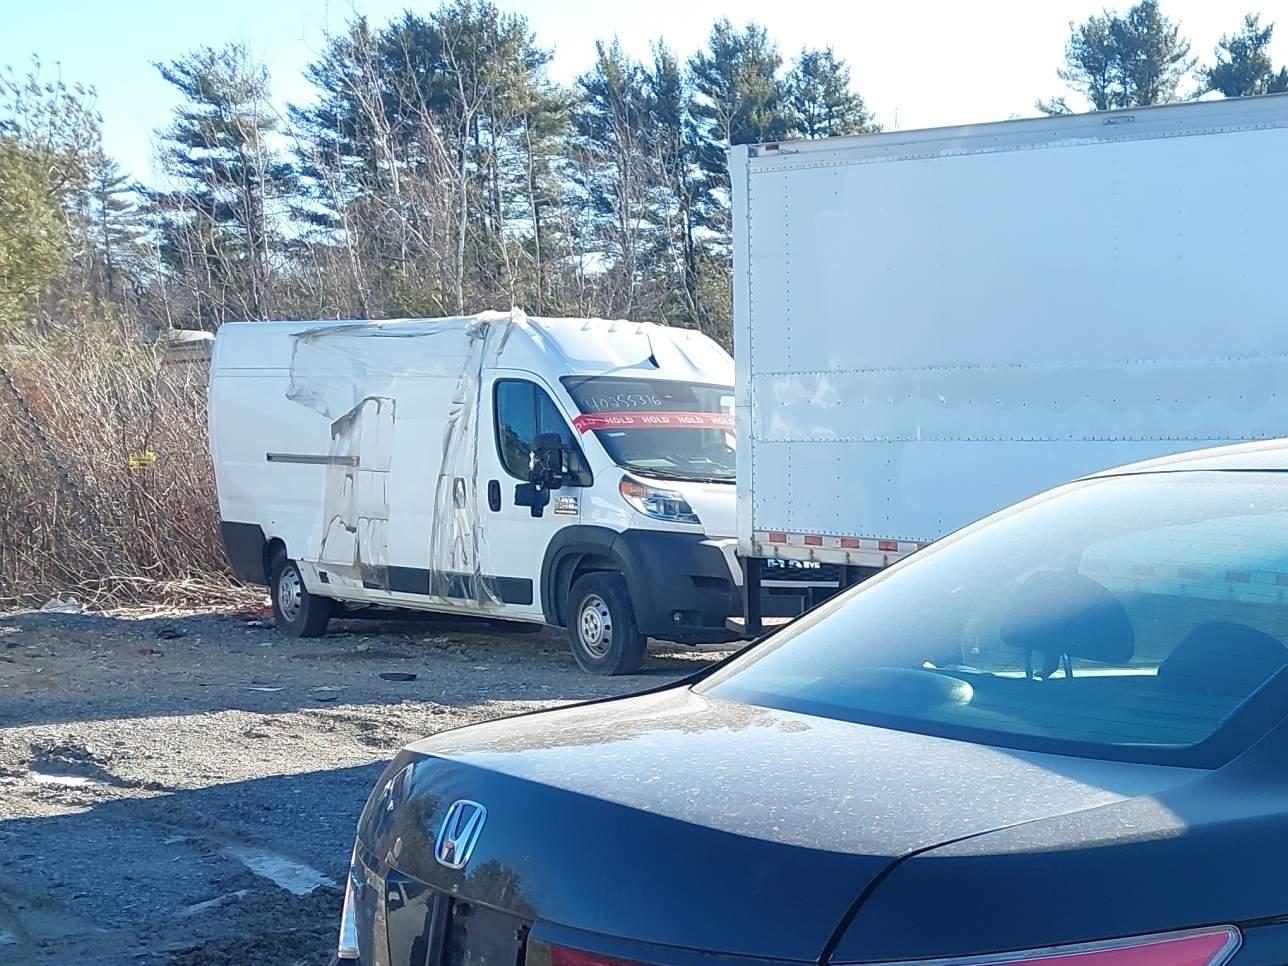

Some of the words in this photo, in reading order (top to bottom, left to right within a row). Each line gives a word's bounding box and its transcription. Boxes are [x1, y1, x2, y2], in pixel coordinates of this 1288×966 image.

[574, 417, 597, 432] OLD
[606, 416, 634, 424] HOLD
[642, 416, 670, 424] HOLD
[678, 416, 704, 424] HOLD
